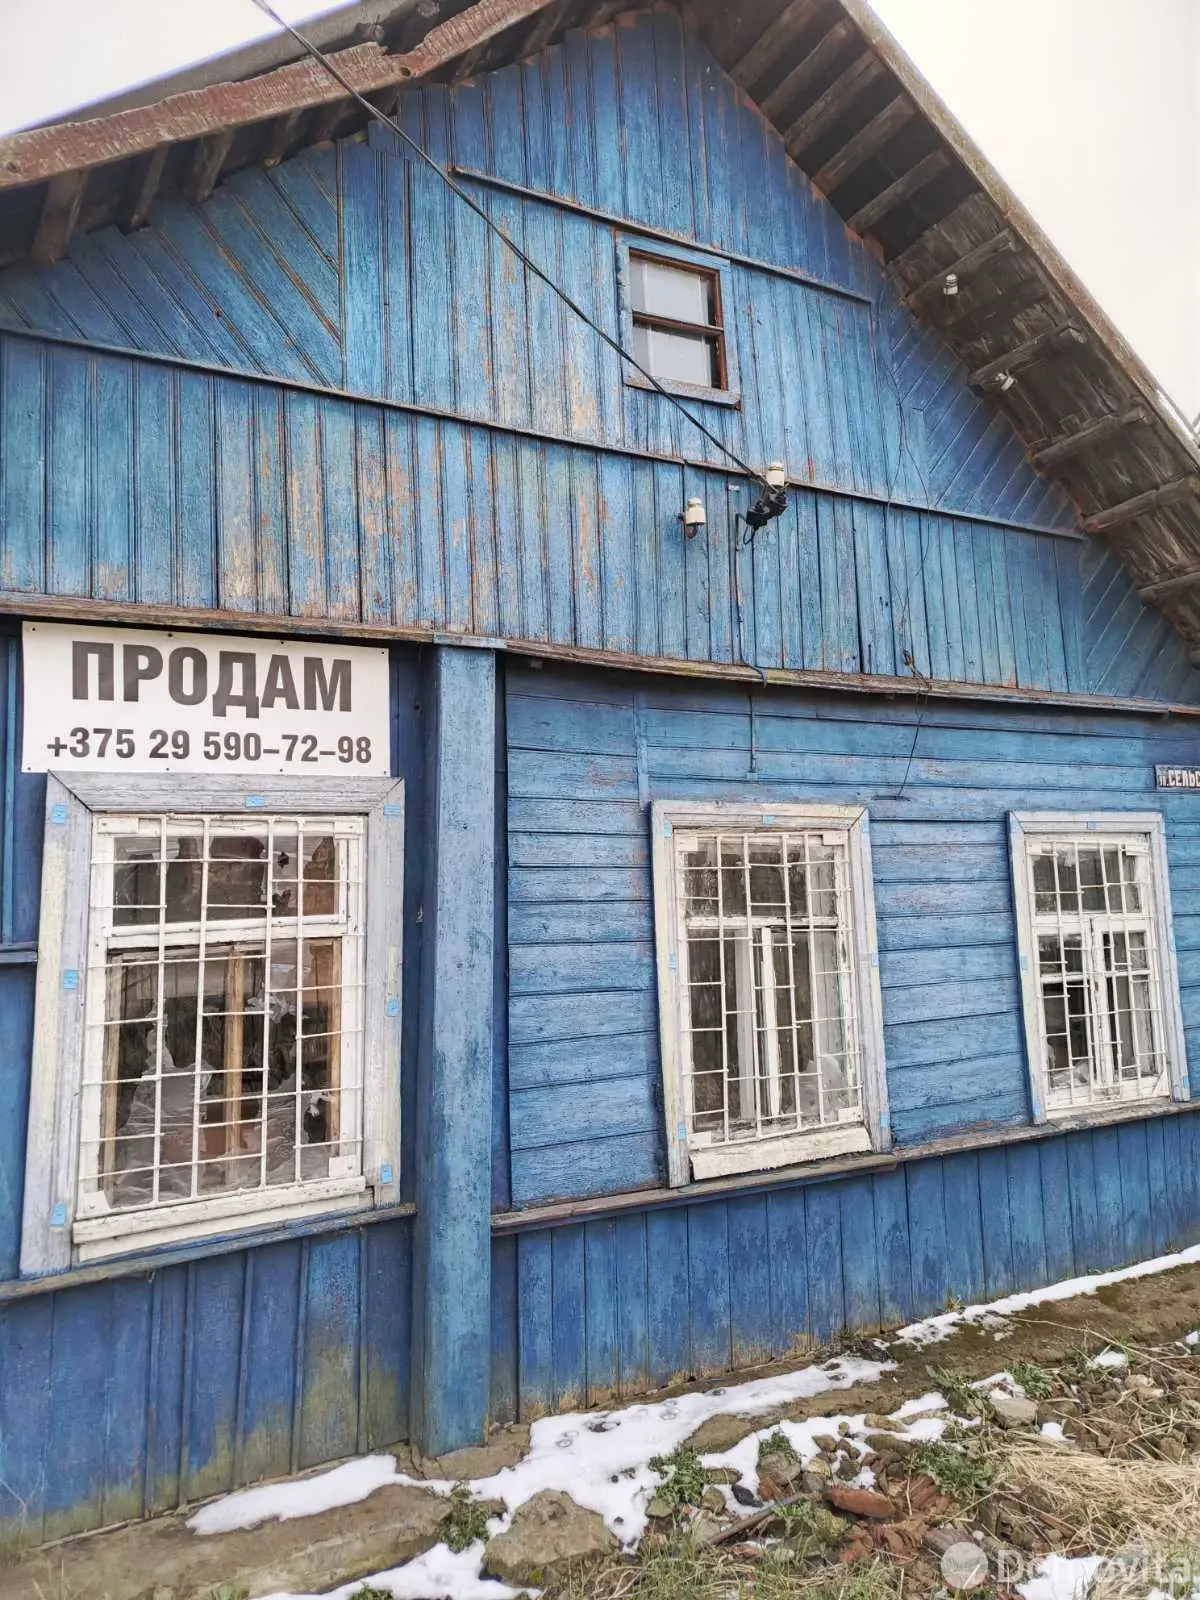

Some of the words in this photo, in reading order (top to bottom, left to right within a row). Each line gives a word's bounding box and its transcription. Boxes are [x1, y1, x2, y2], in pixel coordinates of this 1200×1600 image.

[72, 640, 352, 719] ПРОДАМ
[47, 727, 136, 759] +375
[149, 729, 191, 760] 29
[203, 731, 372, 764] 590-72-98
